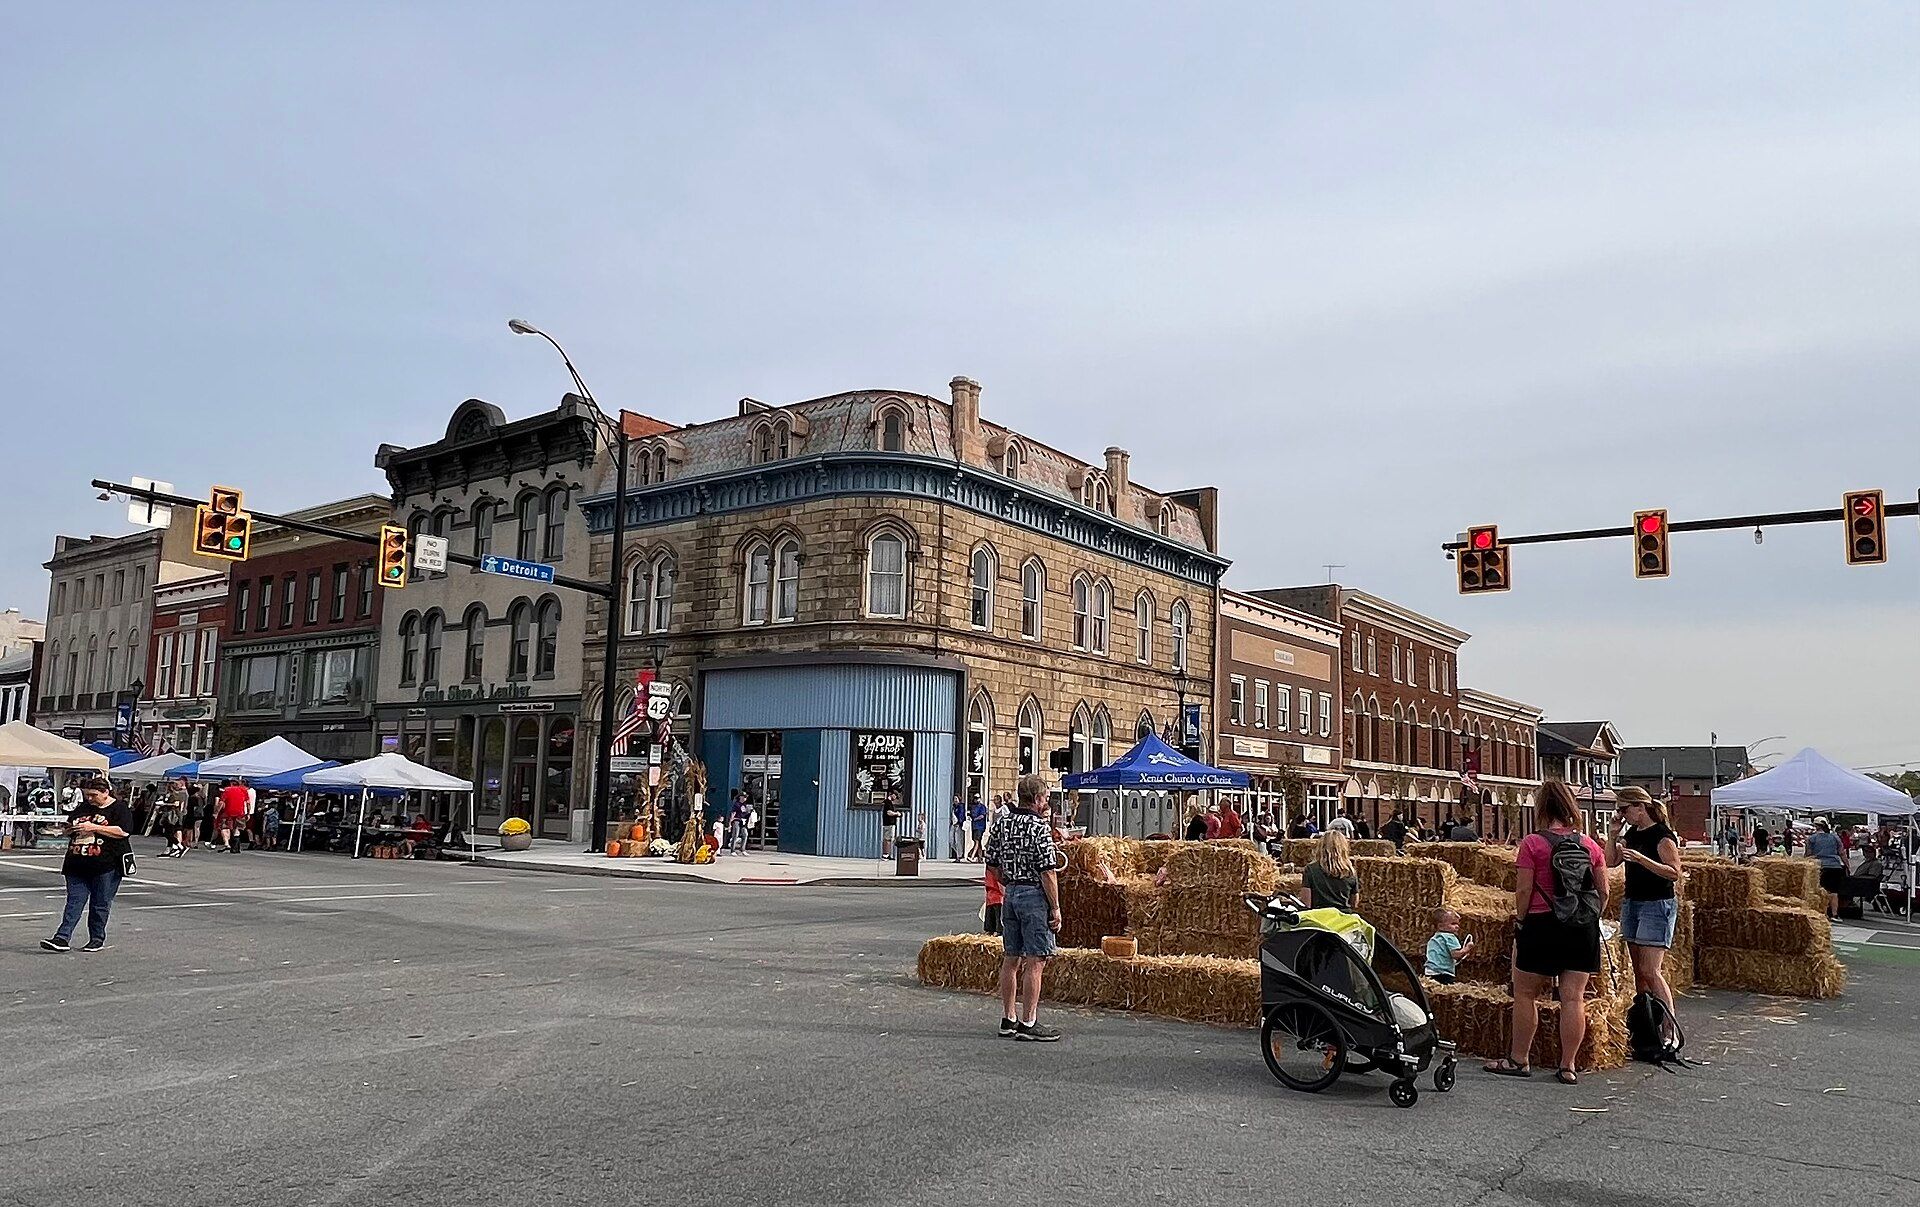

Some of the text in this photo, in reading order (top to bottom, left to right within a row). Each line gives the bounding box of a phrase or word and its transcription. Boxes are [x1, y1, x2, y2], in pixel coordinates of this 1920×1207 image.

[426, 540, 438, 548] NO
[423, 548, 440, 557] TURN
[429, 558, 442, 567] RED
[502, 561, 538, 577] Detroit
[650, 684, 671, 694] NORTH
[650, 701, 668, 715] 42
[858, 734, 905, 748] FLOUR
[880, 745, 901, 755] shop
[1139, 773, 1232, 785] Xenia Church of Christ
[1321, 984, 1374, 1014] BURLEY
